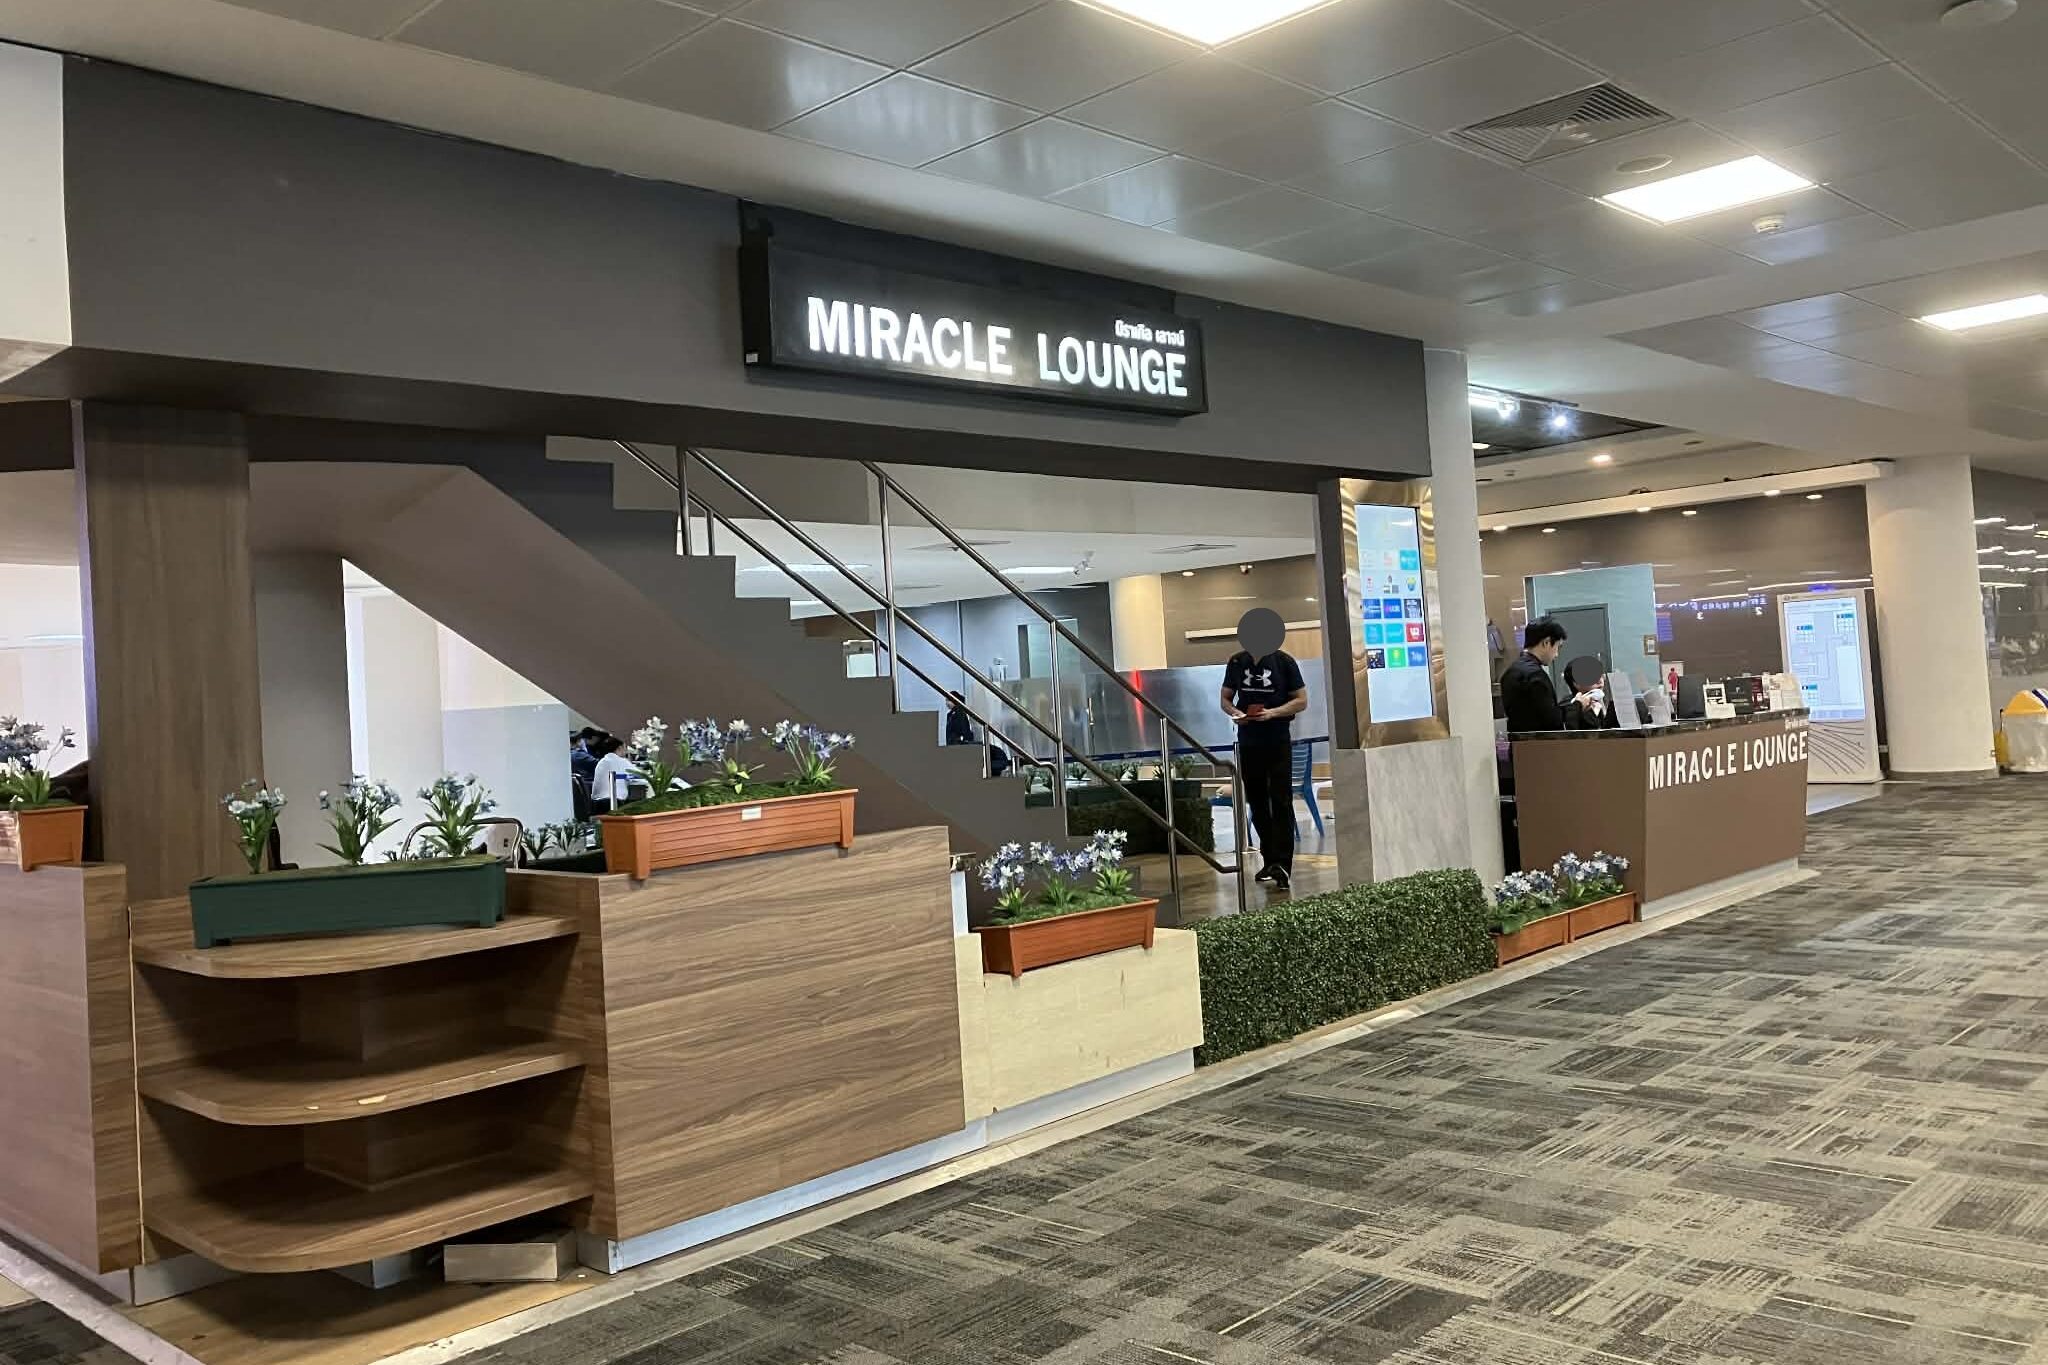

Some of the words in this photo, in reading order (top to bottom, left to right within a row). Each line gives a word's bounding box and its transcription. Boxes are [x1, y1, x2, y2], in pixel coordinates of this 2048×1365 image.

[807, 296, 1013, 376] MIRACLE
[1037, 332, 1188, 397] LOUNGE
[1649, 742, 1737, 790] MIRACLE
[1743, 731, 1808, 772] LOUNGE
